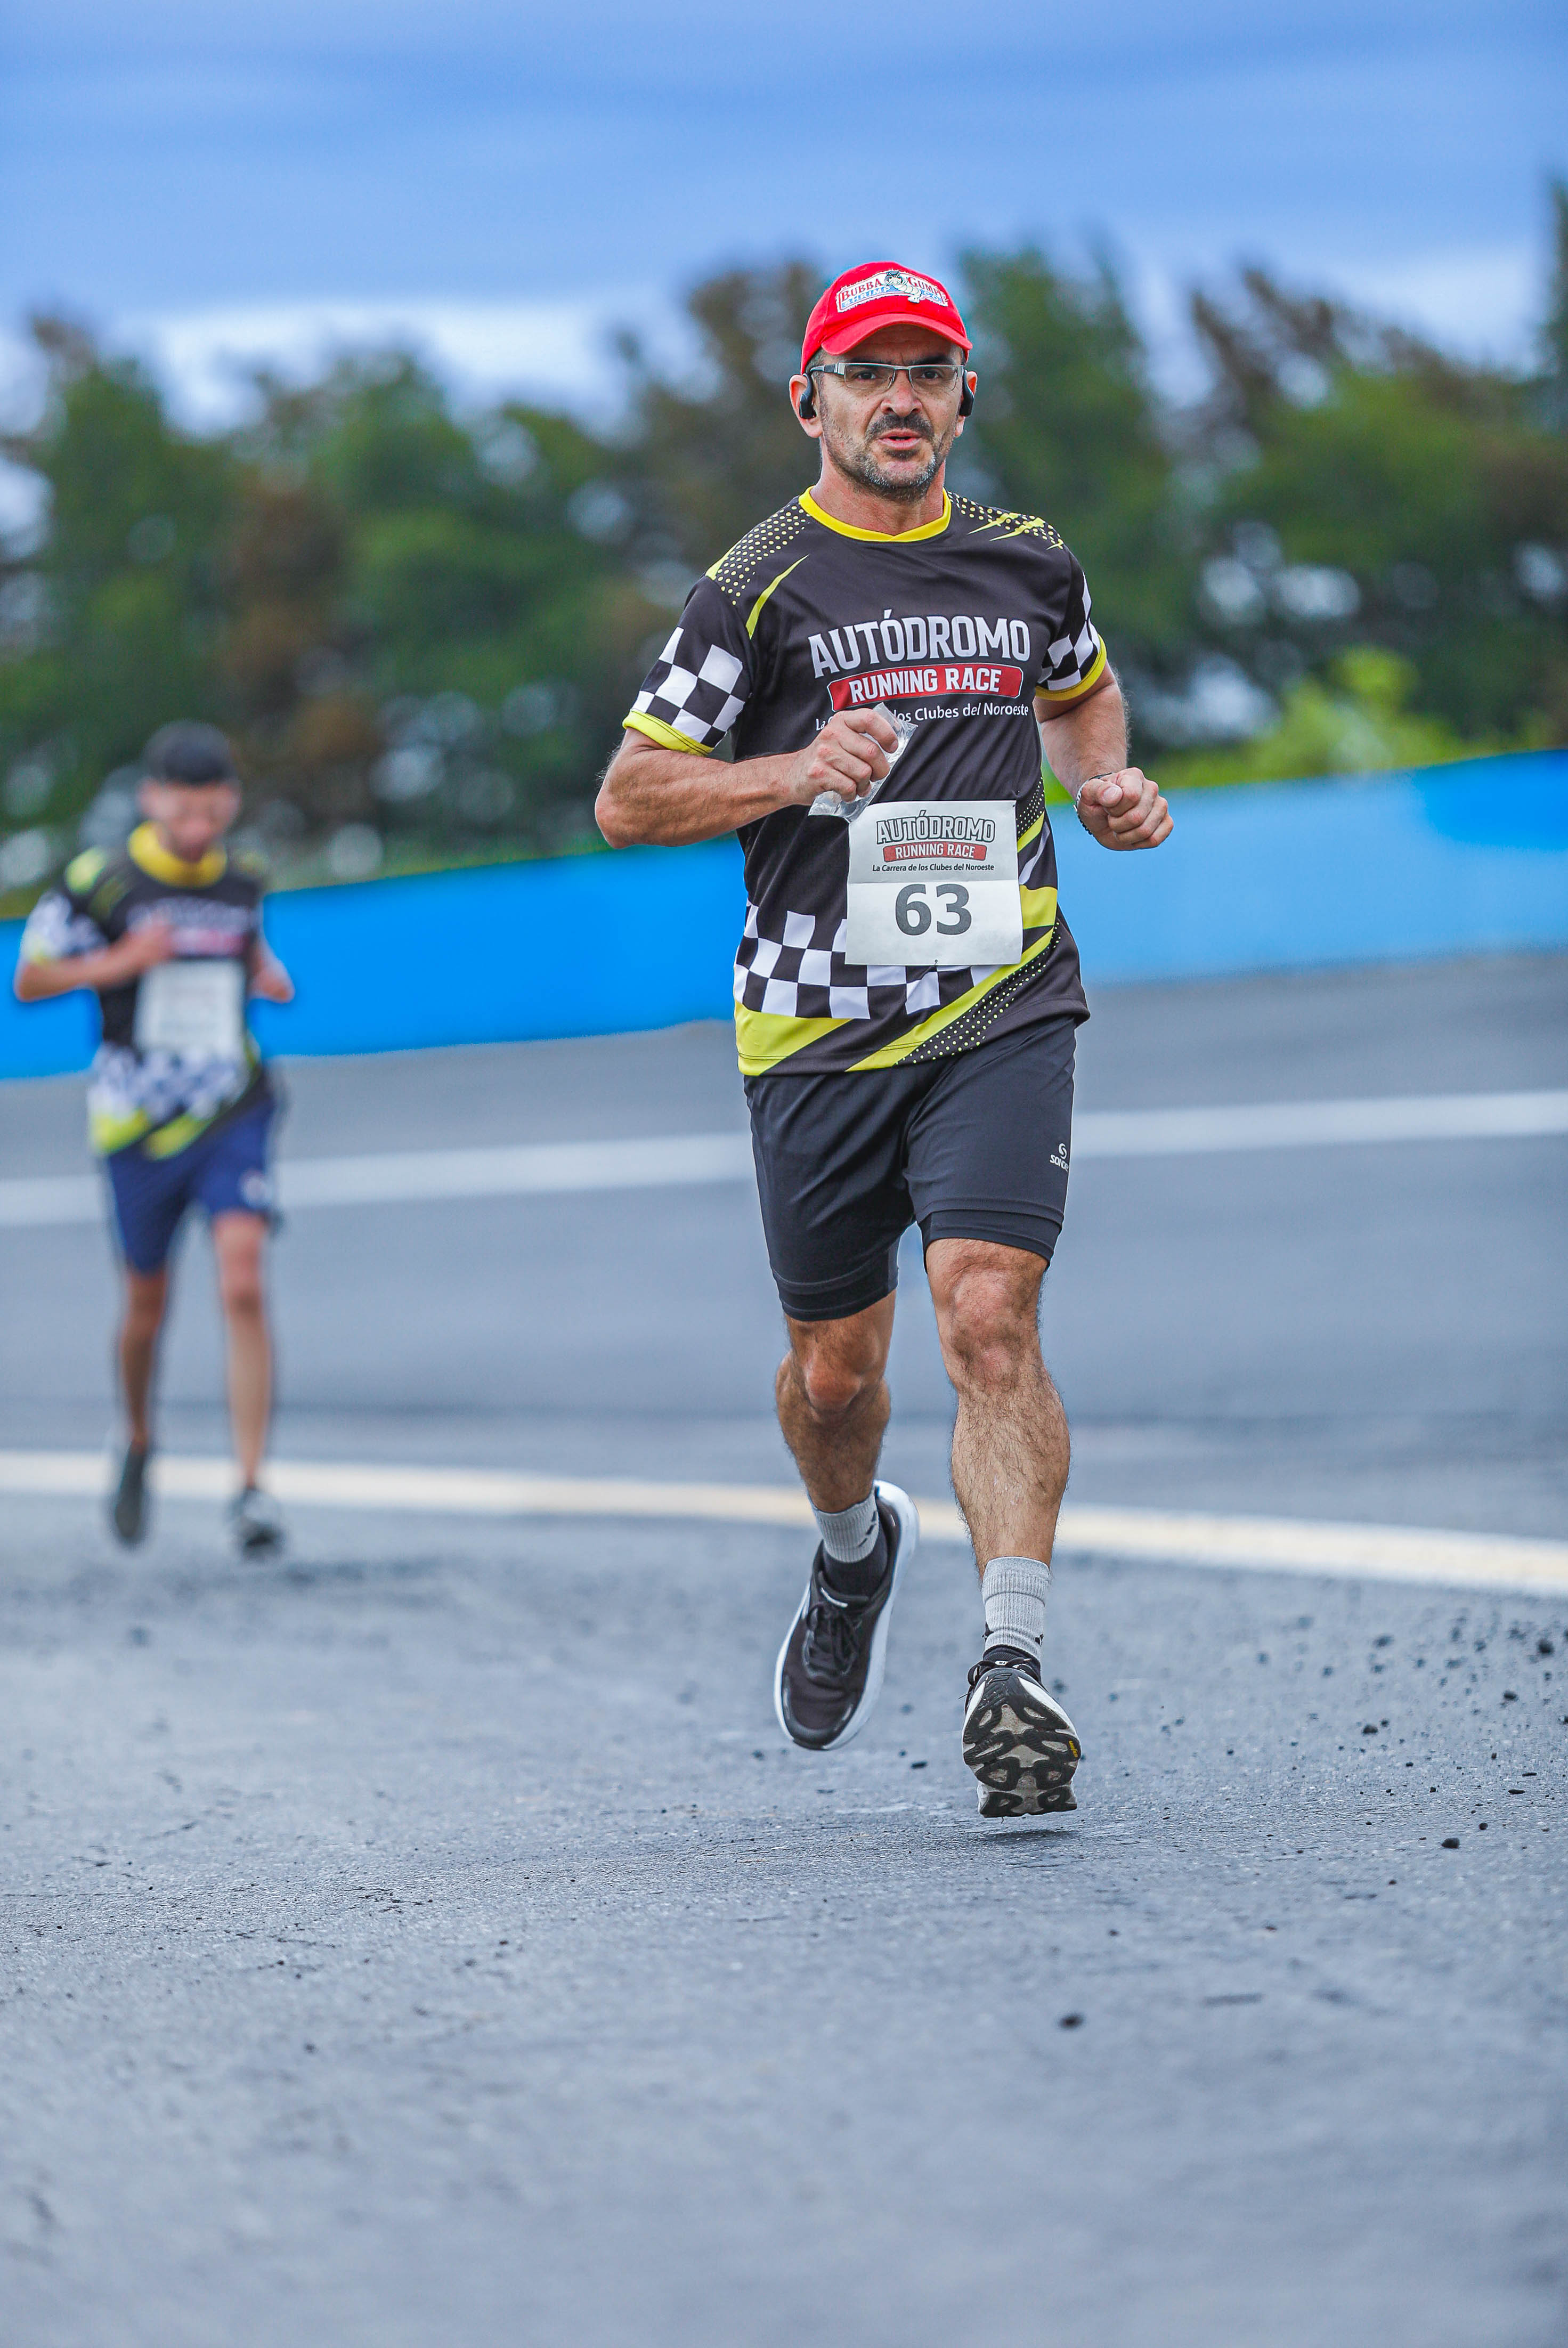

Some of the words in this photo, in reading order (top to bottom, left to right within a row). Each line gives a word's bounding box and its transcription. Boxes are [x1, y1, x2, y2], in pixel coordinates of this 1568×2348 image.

[841, 279, 882, 301] BUBBA
[907, 277, 941, 296] GUMP
[808, 609, 1030, 678] AUTÓDROMO
[849, 669, 938, 703] RUNNING
[945, 667, 1001, 693] RACE
[816, 718, 825, 731] La
[915, 705, 959, 721] Clubes
[962, 702, 981, 716] del
[984, 702, 1029, 716] Noroeste
[876, 810, 995, 844] AUTÓDROMO
[895, 842, 944, 859] RUNNING
[947, 843, 976, 858] RACE
[896, 883, 972, 936] 63
